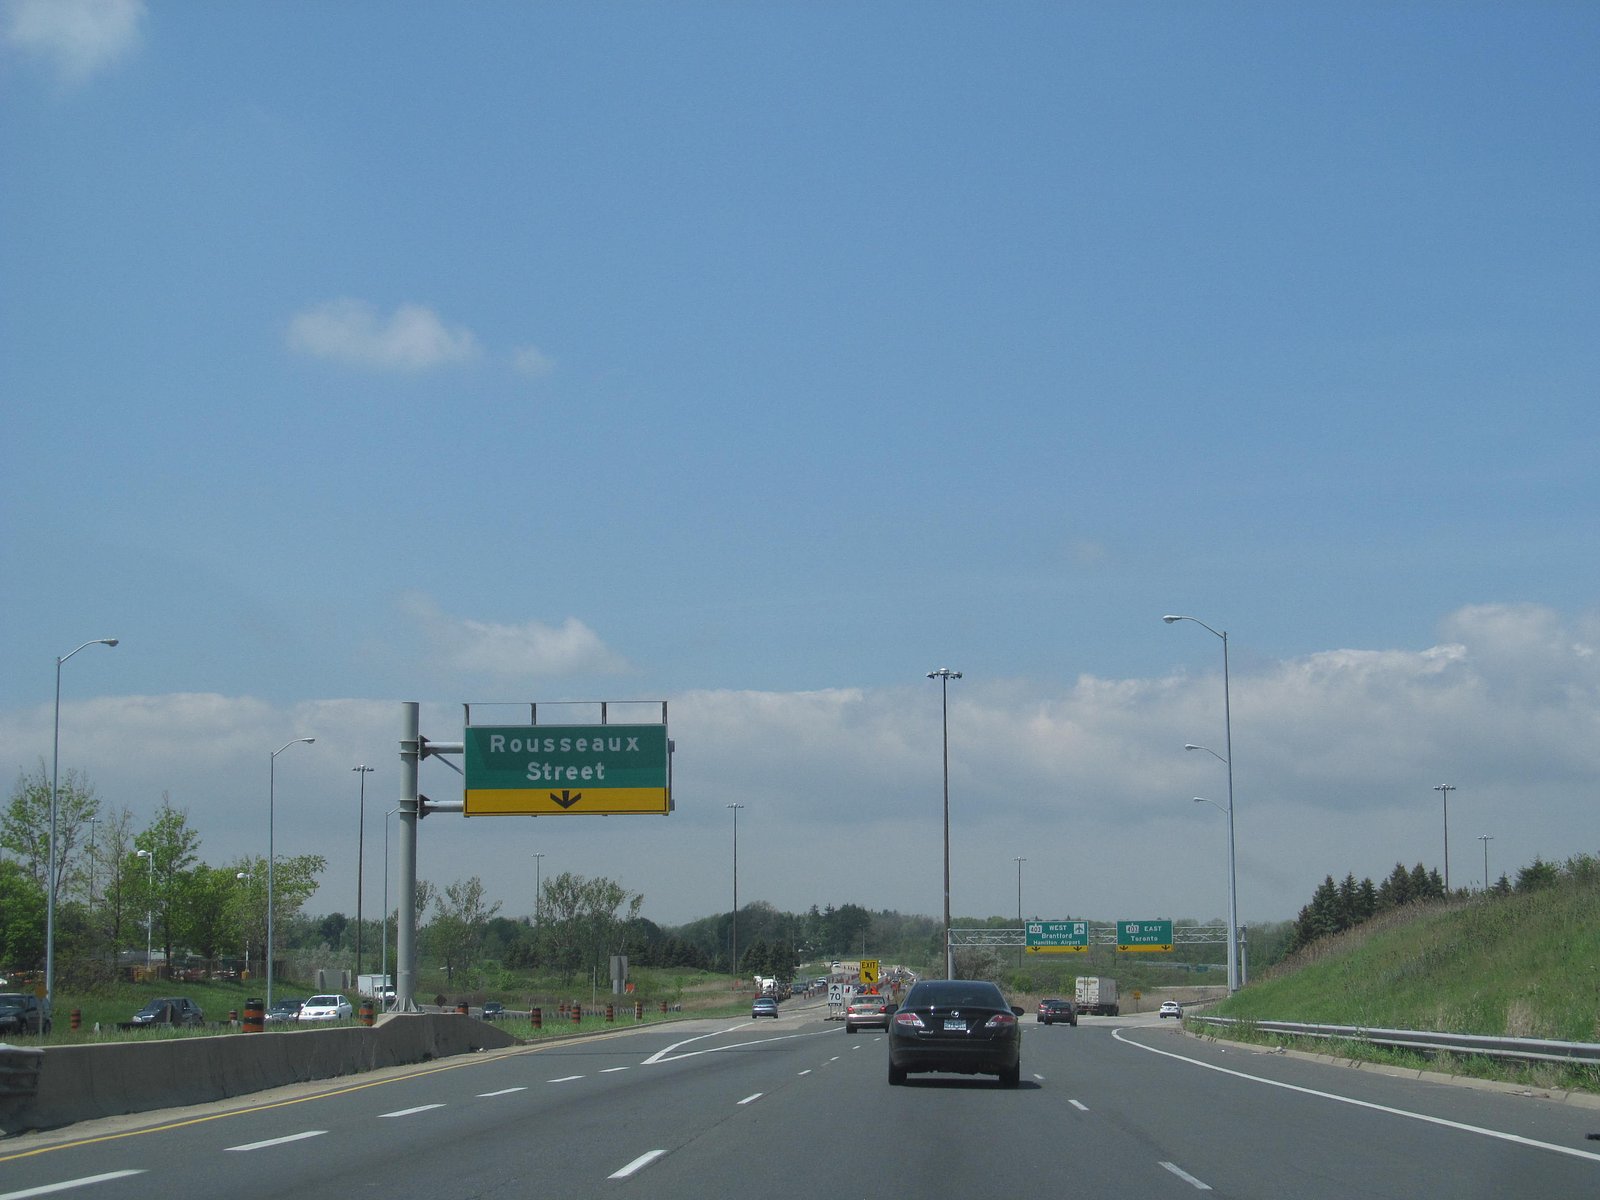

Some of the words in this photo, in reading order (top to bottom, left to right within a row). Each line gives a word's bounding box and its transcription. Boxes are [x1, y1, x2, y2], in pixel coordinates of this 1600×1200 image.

[490, 734, 640, 753] Rousseaux
[526, 761, 605, 781] Street
[861, 961, 876, 969] EXIT
[830, 992, 841, 1001] 70
